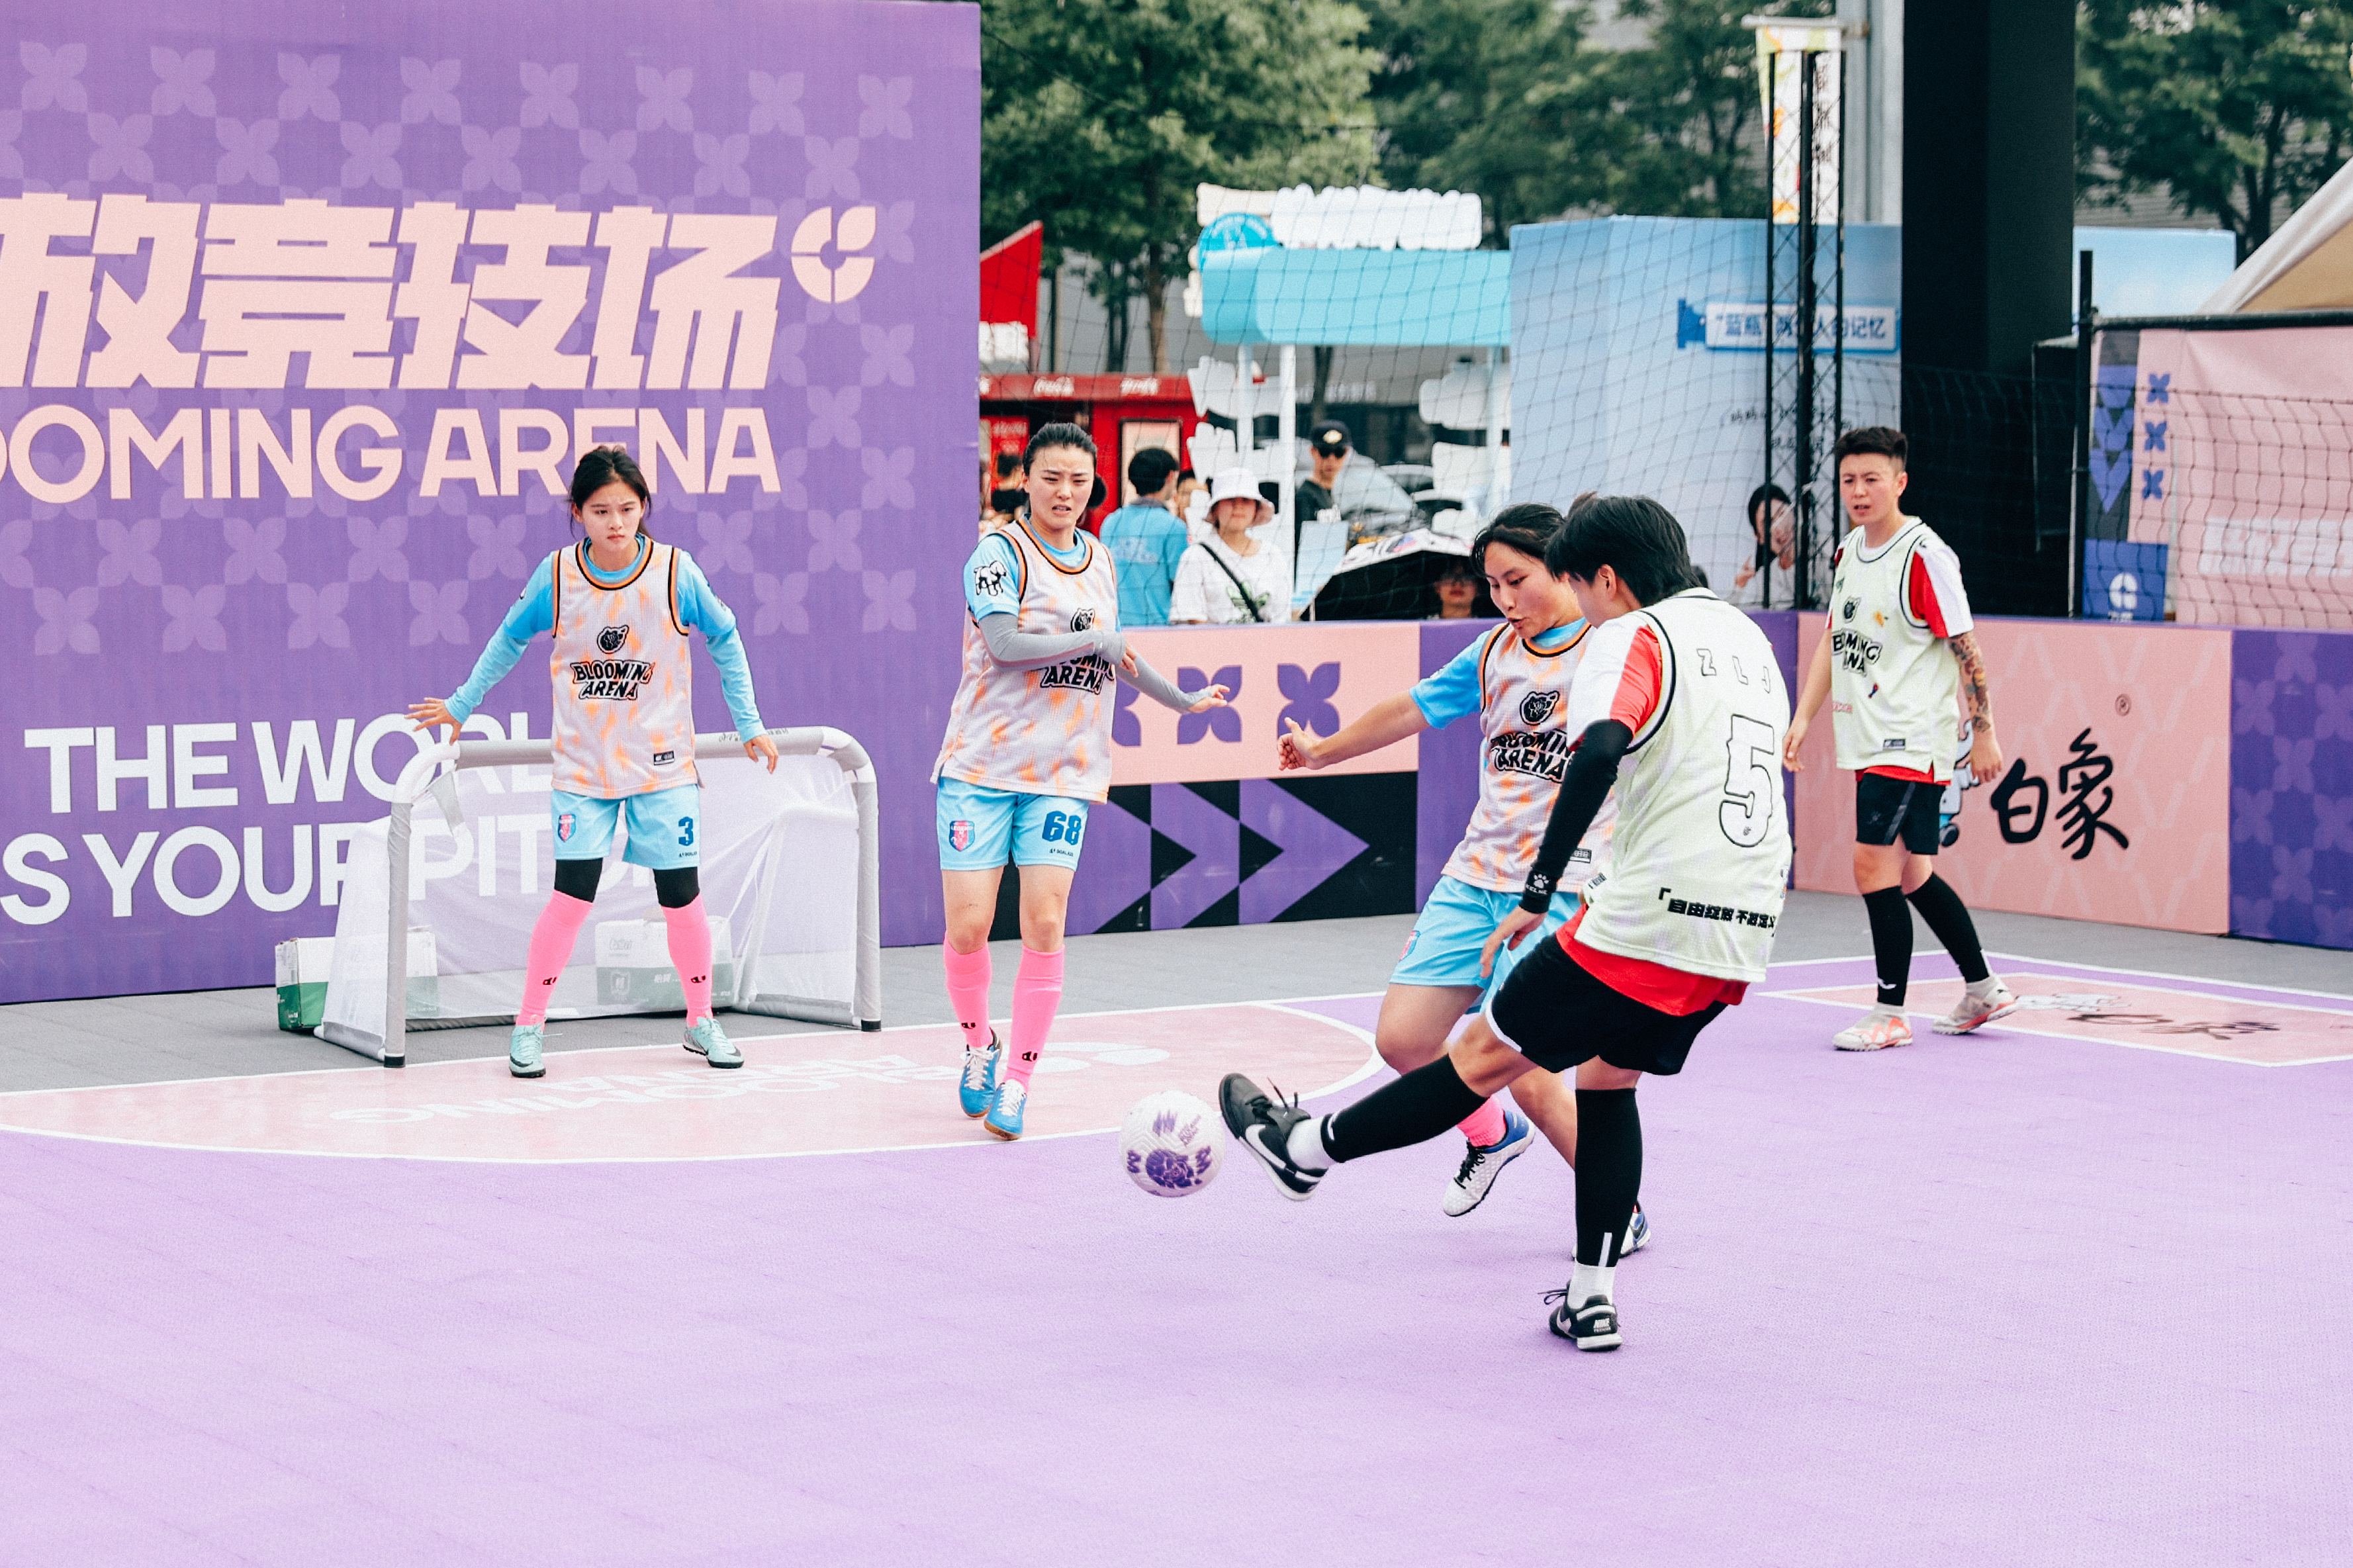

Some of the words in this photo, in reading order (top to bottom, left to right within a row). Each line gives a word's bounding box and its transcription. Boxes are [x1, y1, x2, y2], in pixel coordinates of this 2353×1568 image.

[0, 404, 402, 504] OMING
[582, 680, 638, 698] ARENA
[24, 721, 238, 814] THE
[252, 712, 551, 804] WORL
[1498, 748, 1567, 780] ARENA
[1719, 714, 1775, 848] 5
[1990, 727, 2130, 860] 白象
[678, 816, 694, 847] 3
[1042, 810, 1082, 846] 68
[1594, 1318, 1610, 1326] NIKE
